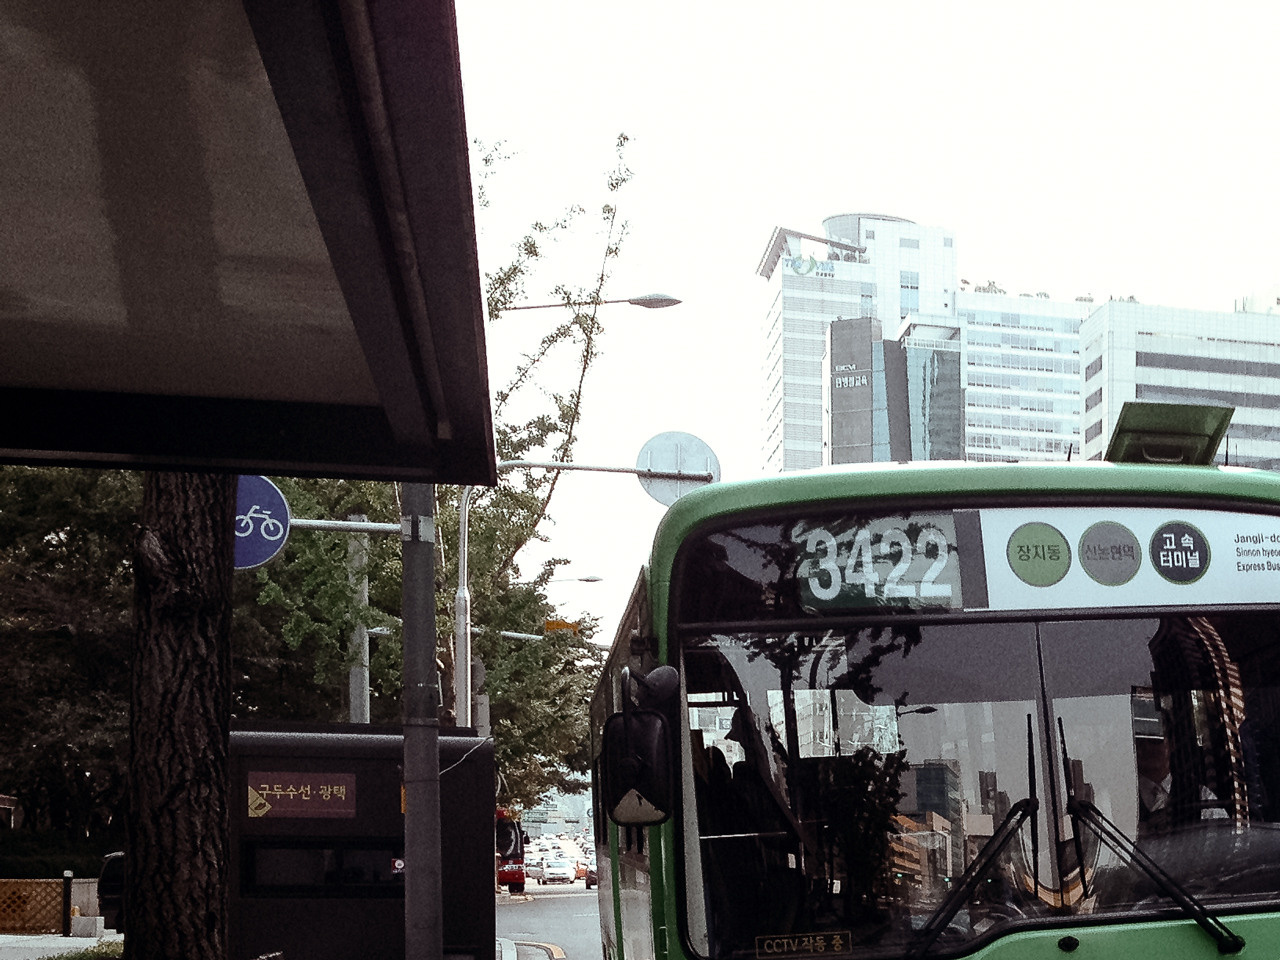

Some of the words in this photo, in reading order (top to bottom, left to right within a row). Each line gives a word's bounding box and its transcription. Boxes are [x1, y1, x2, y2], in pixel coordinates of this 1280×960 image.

[1016, 544, 1062, 562] 장지동
[1159, 550, 1201, 569] 터미널
[805, 527, 952, 600] 3422
[1237, 561, 1266, 572] Express
[1266, 561, 1280, 571] Bus
[764, 938, 799, 953] CCTV
[802, 936, 827, 953] 작동
[832, 935, 843, 952] 중
